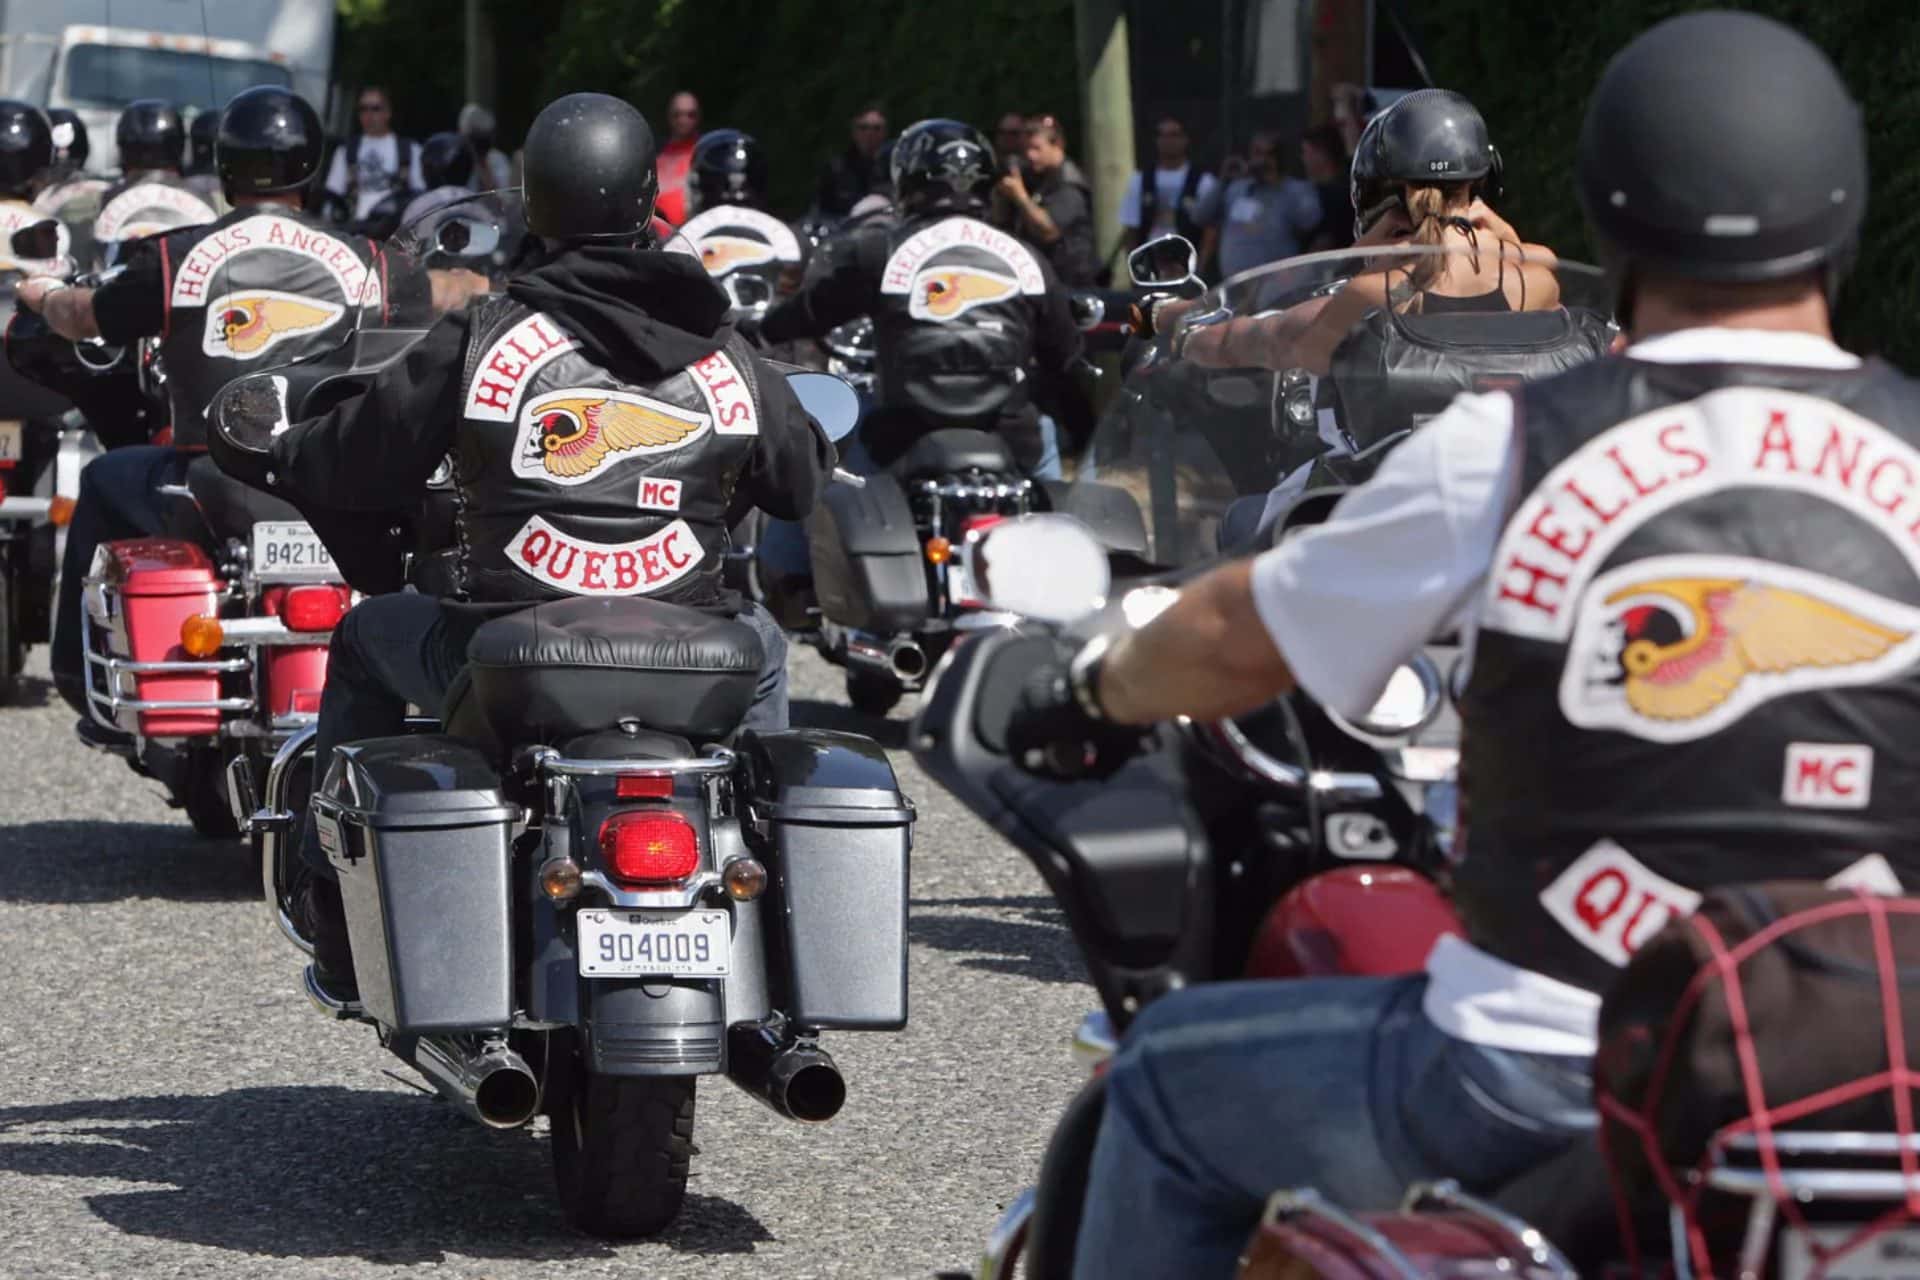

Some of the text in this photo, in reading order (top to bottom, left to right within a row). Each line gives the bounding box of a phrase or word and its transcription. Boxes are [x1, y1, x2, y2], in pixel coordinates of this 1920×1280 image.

[1430, 161, 1449, 171] DOT
[178, 222, 378, 299] HELLS ANGELS
[889, 223, 1040, 287] HELLS ANGELS
[475, 322, 751, 427] HELL ELS
[642, 483, 676, 506] MC
[1499, 411, 1920, 618] HELLS ANG
[520, 529, 692, 590] QUEBEC
[1796, 758, 1856, 796] MC
[599, 933, 709, 962] 904009
